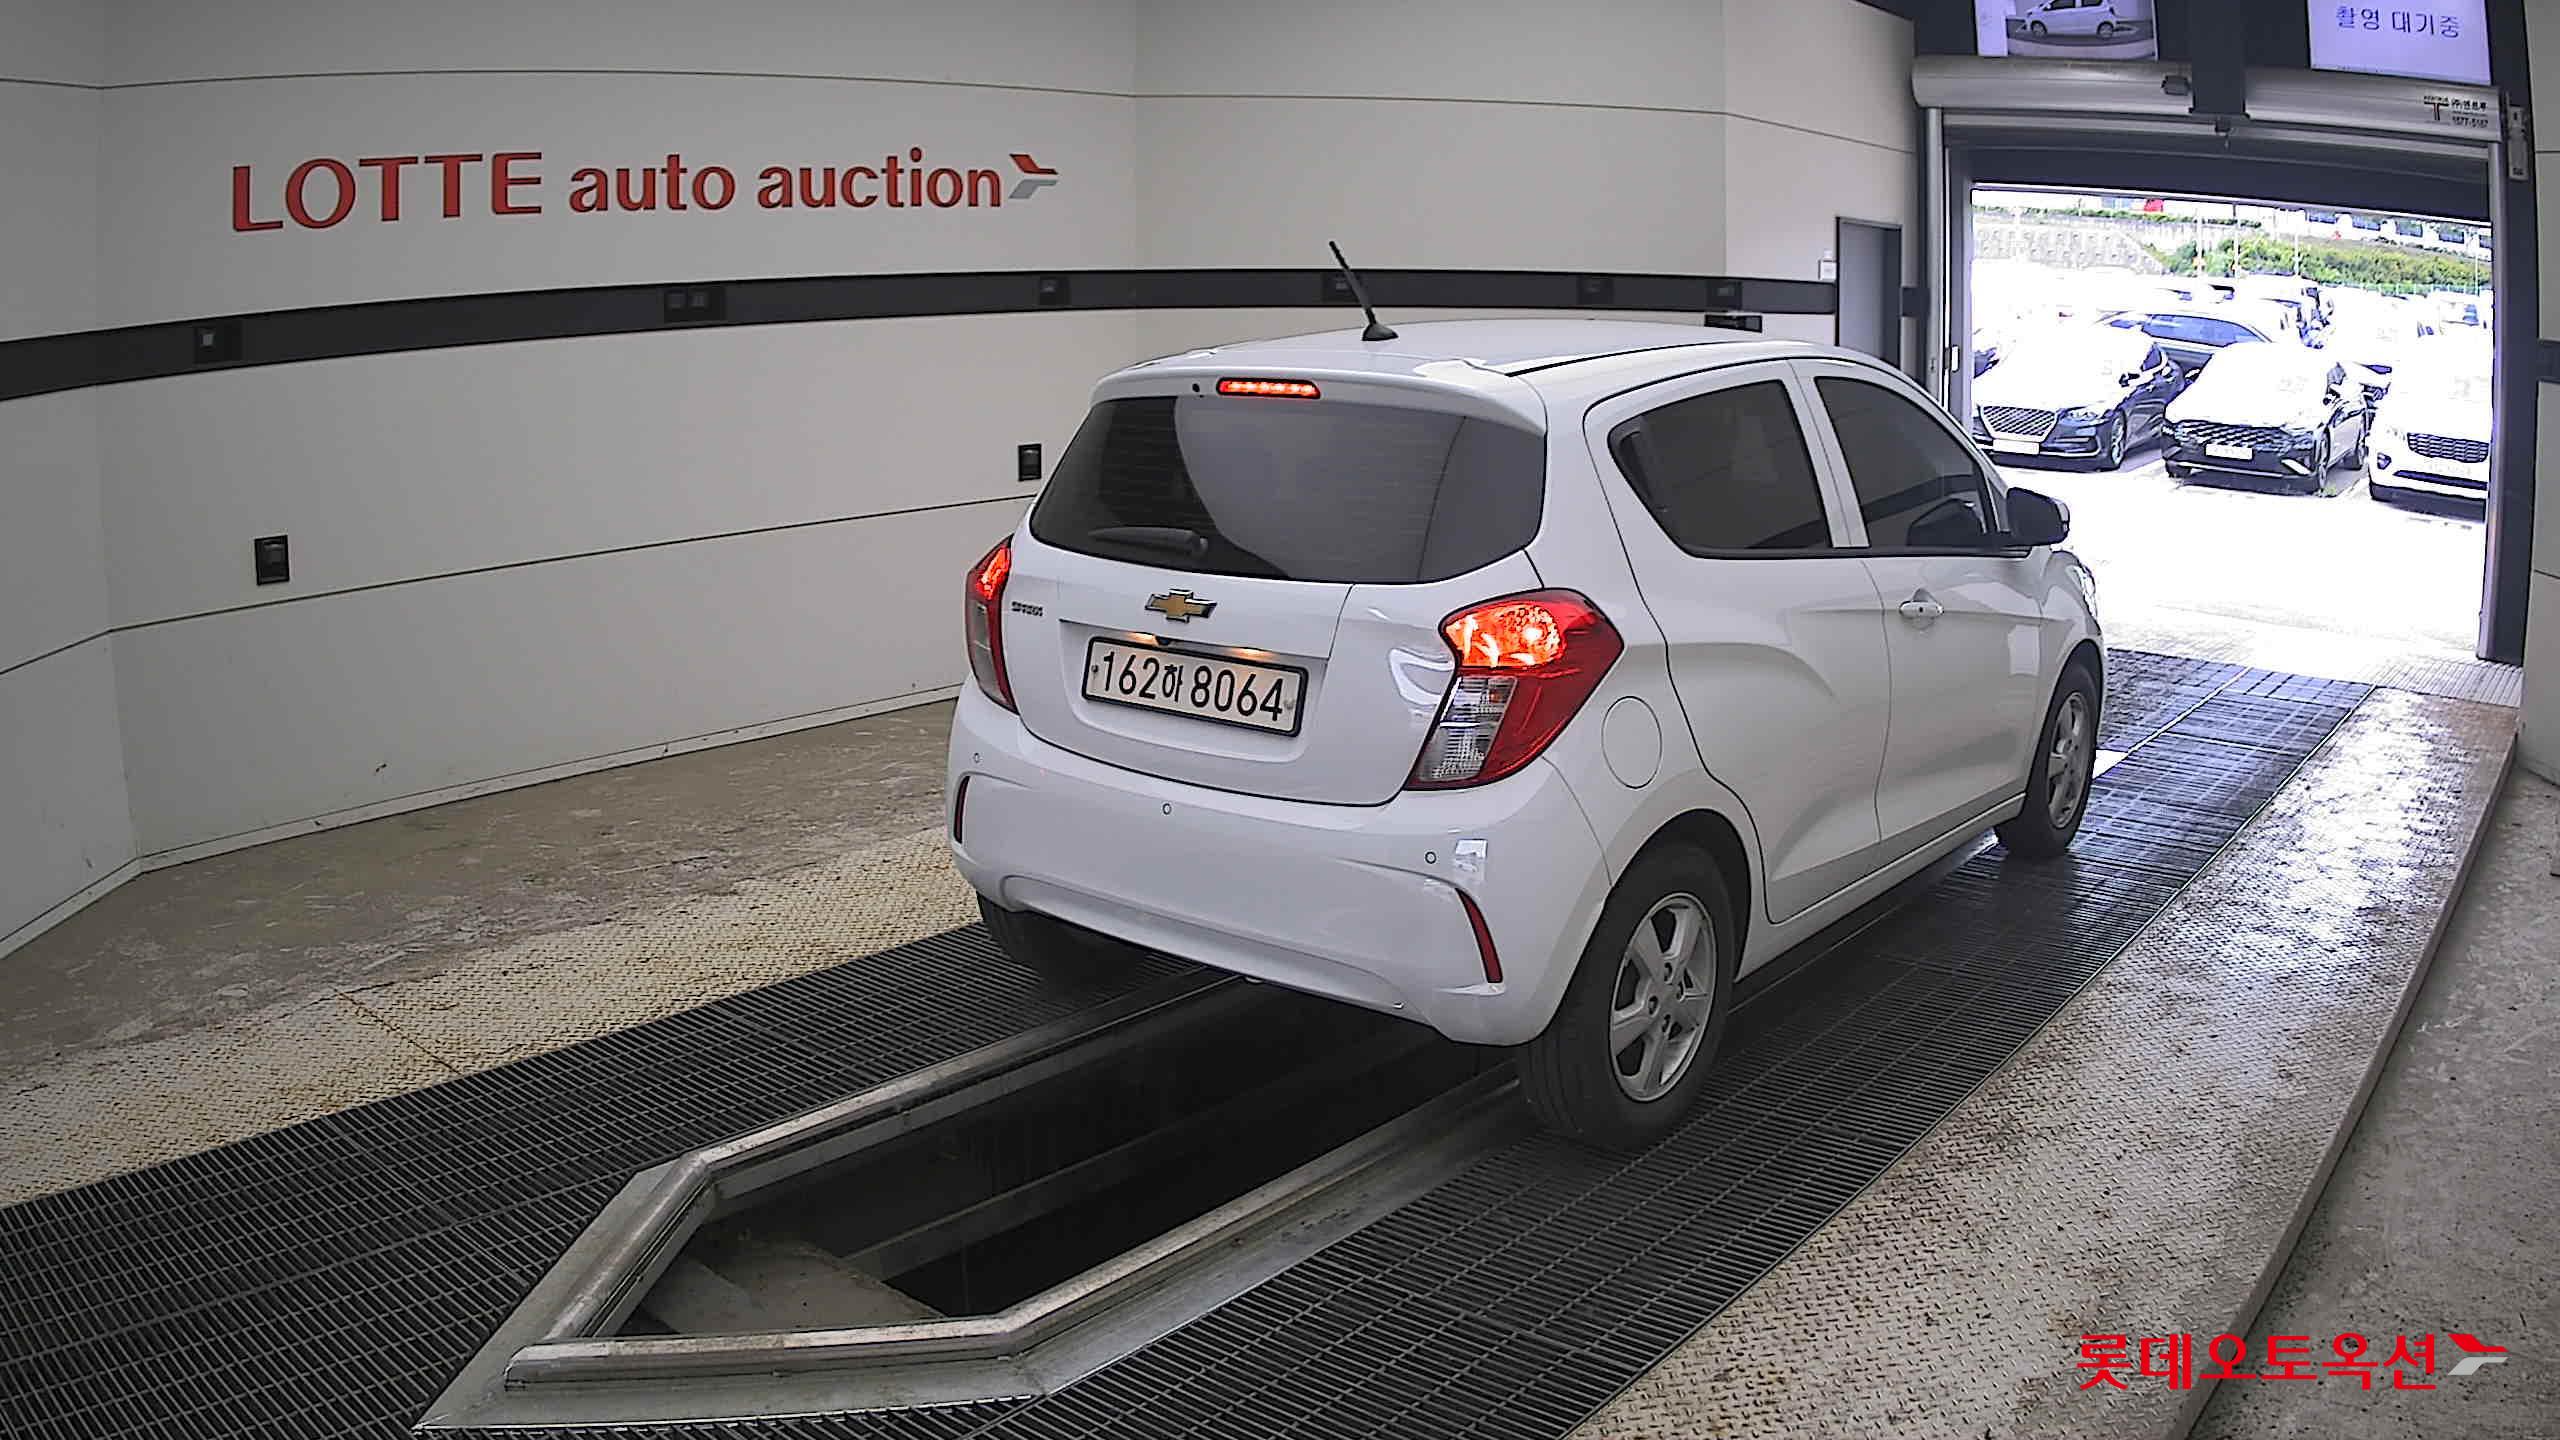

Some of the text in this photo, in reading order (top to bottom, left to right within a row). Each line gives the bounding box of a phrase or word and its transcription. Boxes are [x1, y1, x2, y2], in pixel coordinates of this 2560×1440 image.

[2391, 11, 2460, 39] 대기중
[231, 147, 1002, 233] LOTTE auto auction
[1102, 650, 1284, 722] 162하 8064
